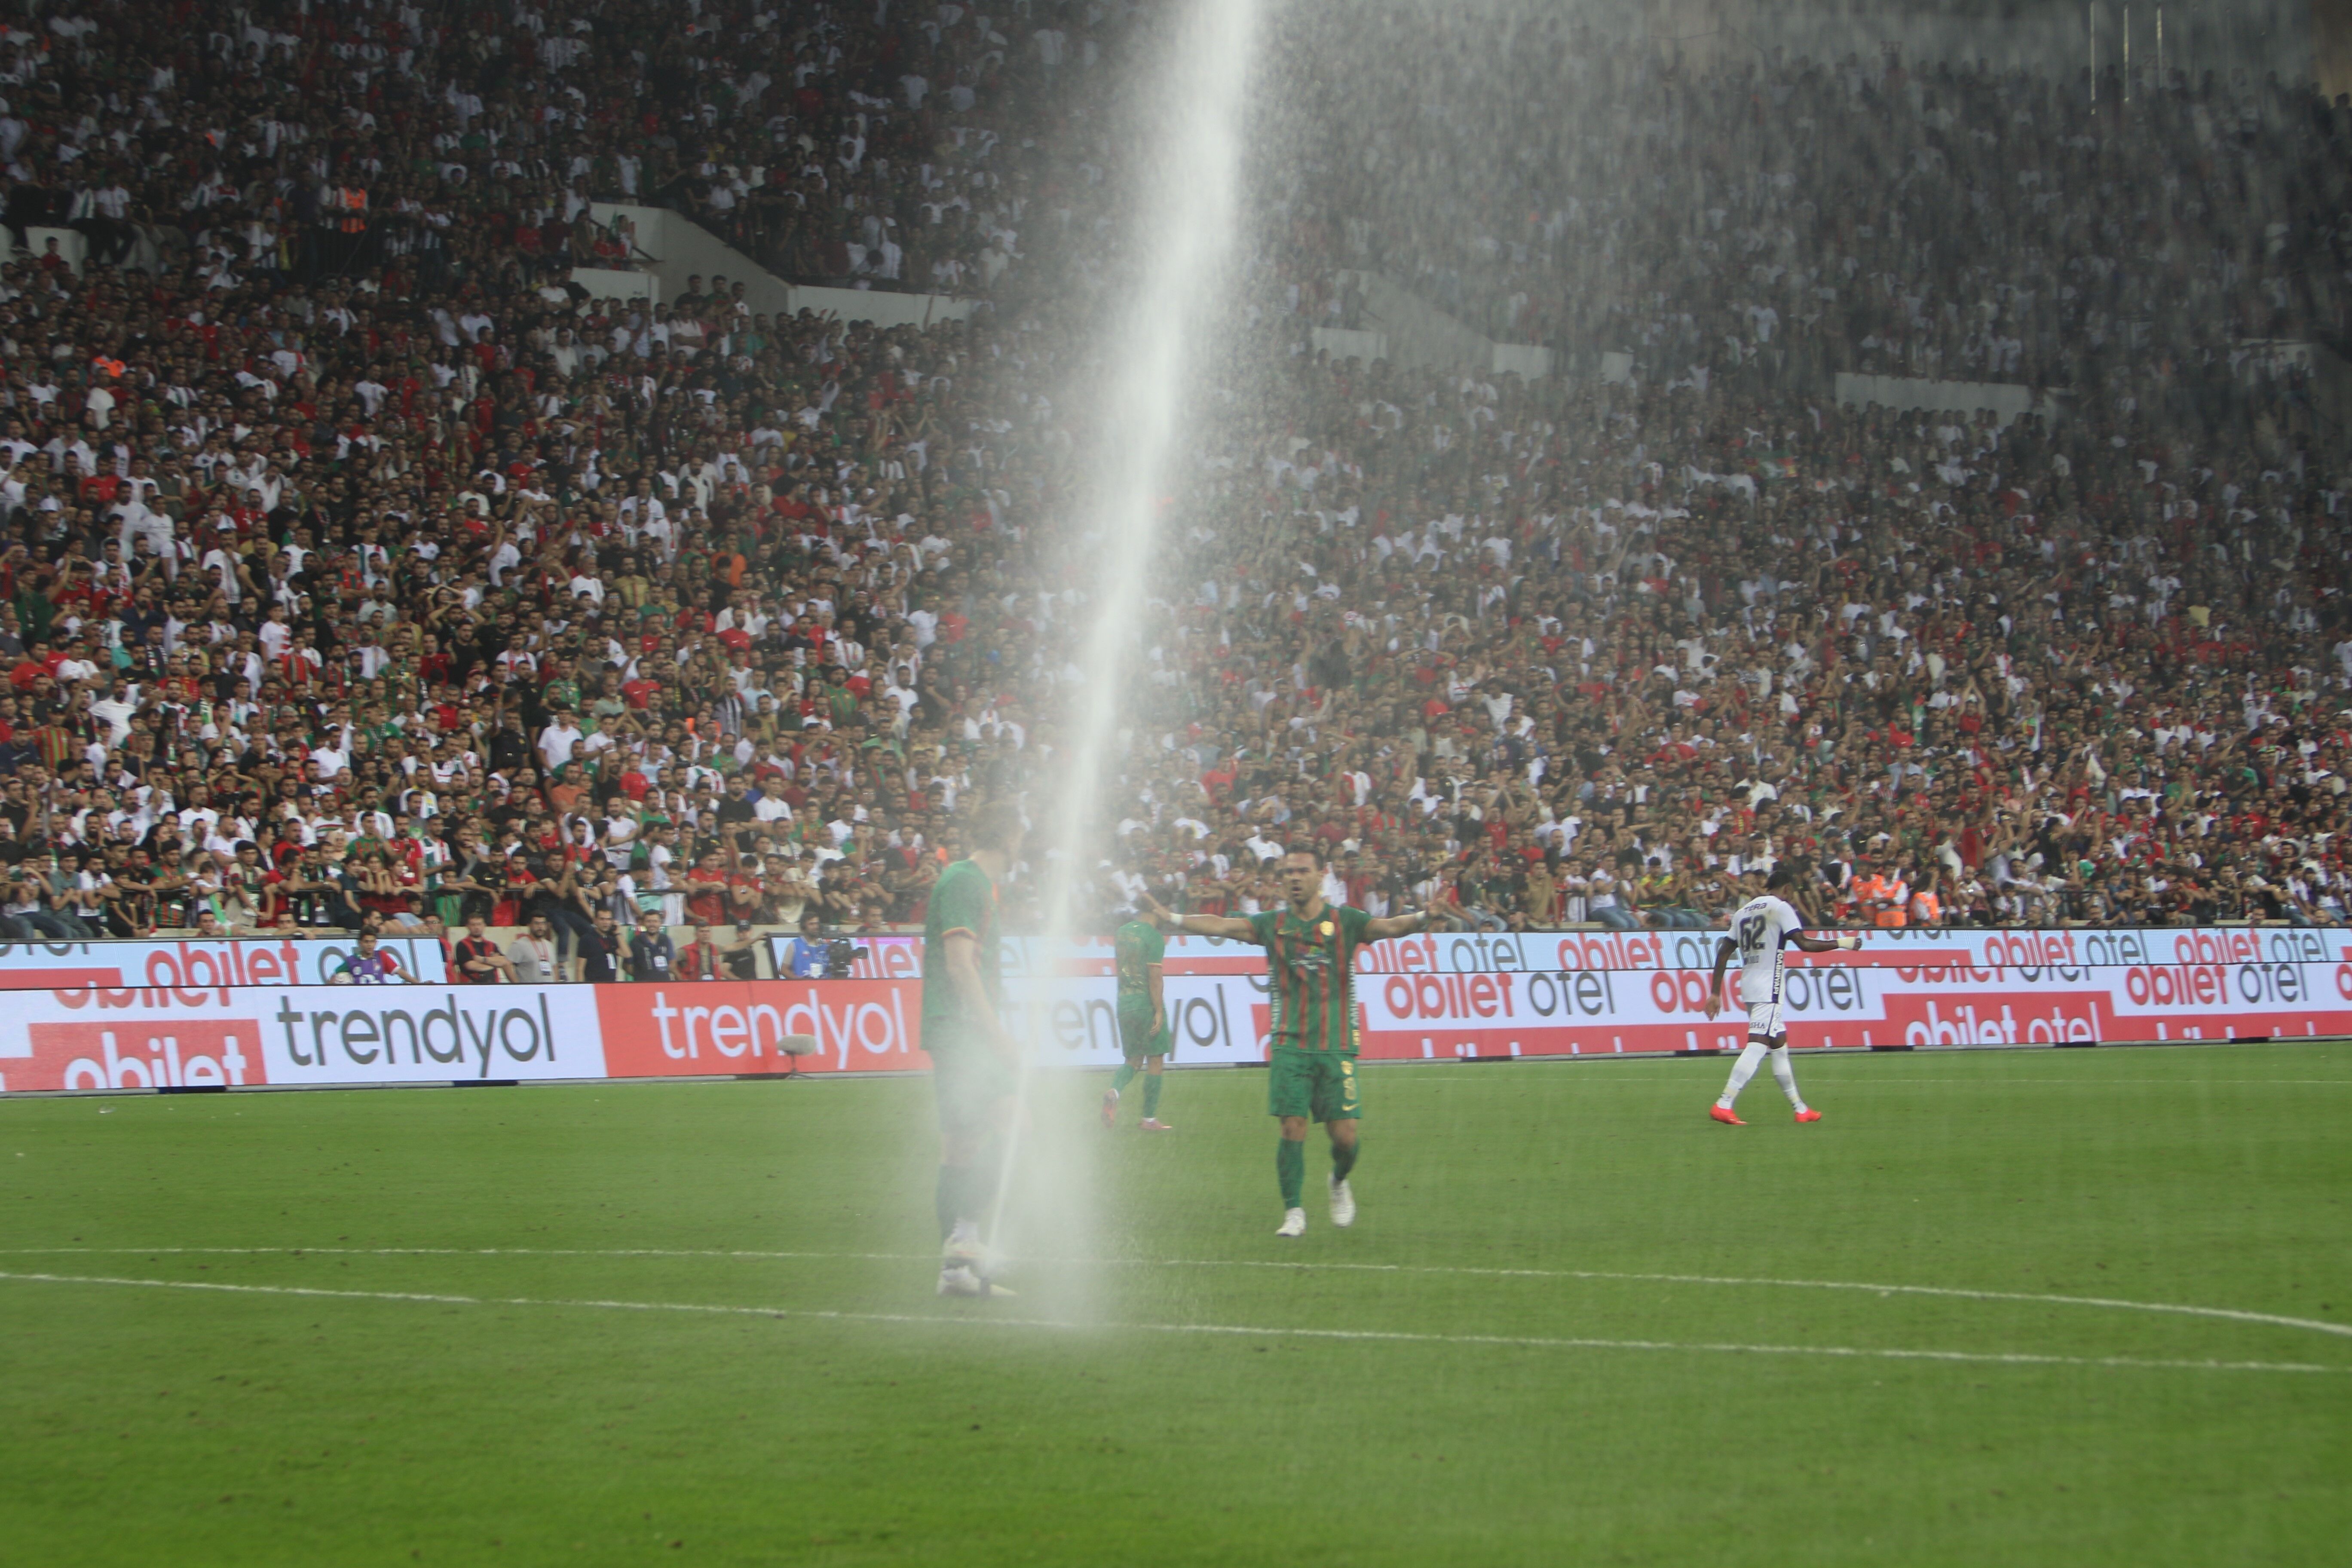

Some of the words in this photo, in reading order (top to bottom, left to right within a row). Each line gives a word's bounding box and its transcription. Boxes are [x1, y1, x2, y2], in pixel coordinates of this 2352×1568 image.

[1384, 972, 1514, 1019] obilet
[1528, 970, 1615, 1016] otel
[2126, 964, 2228, 1005] obilet
[2239, 962, 2309, 1003] otel
[277, 992, 555, 1078] trendyol
[652, 988, 908, 1069] trendyol
